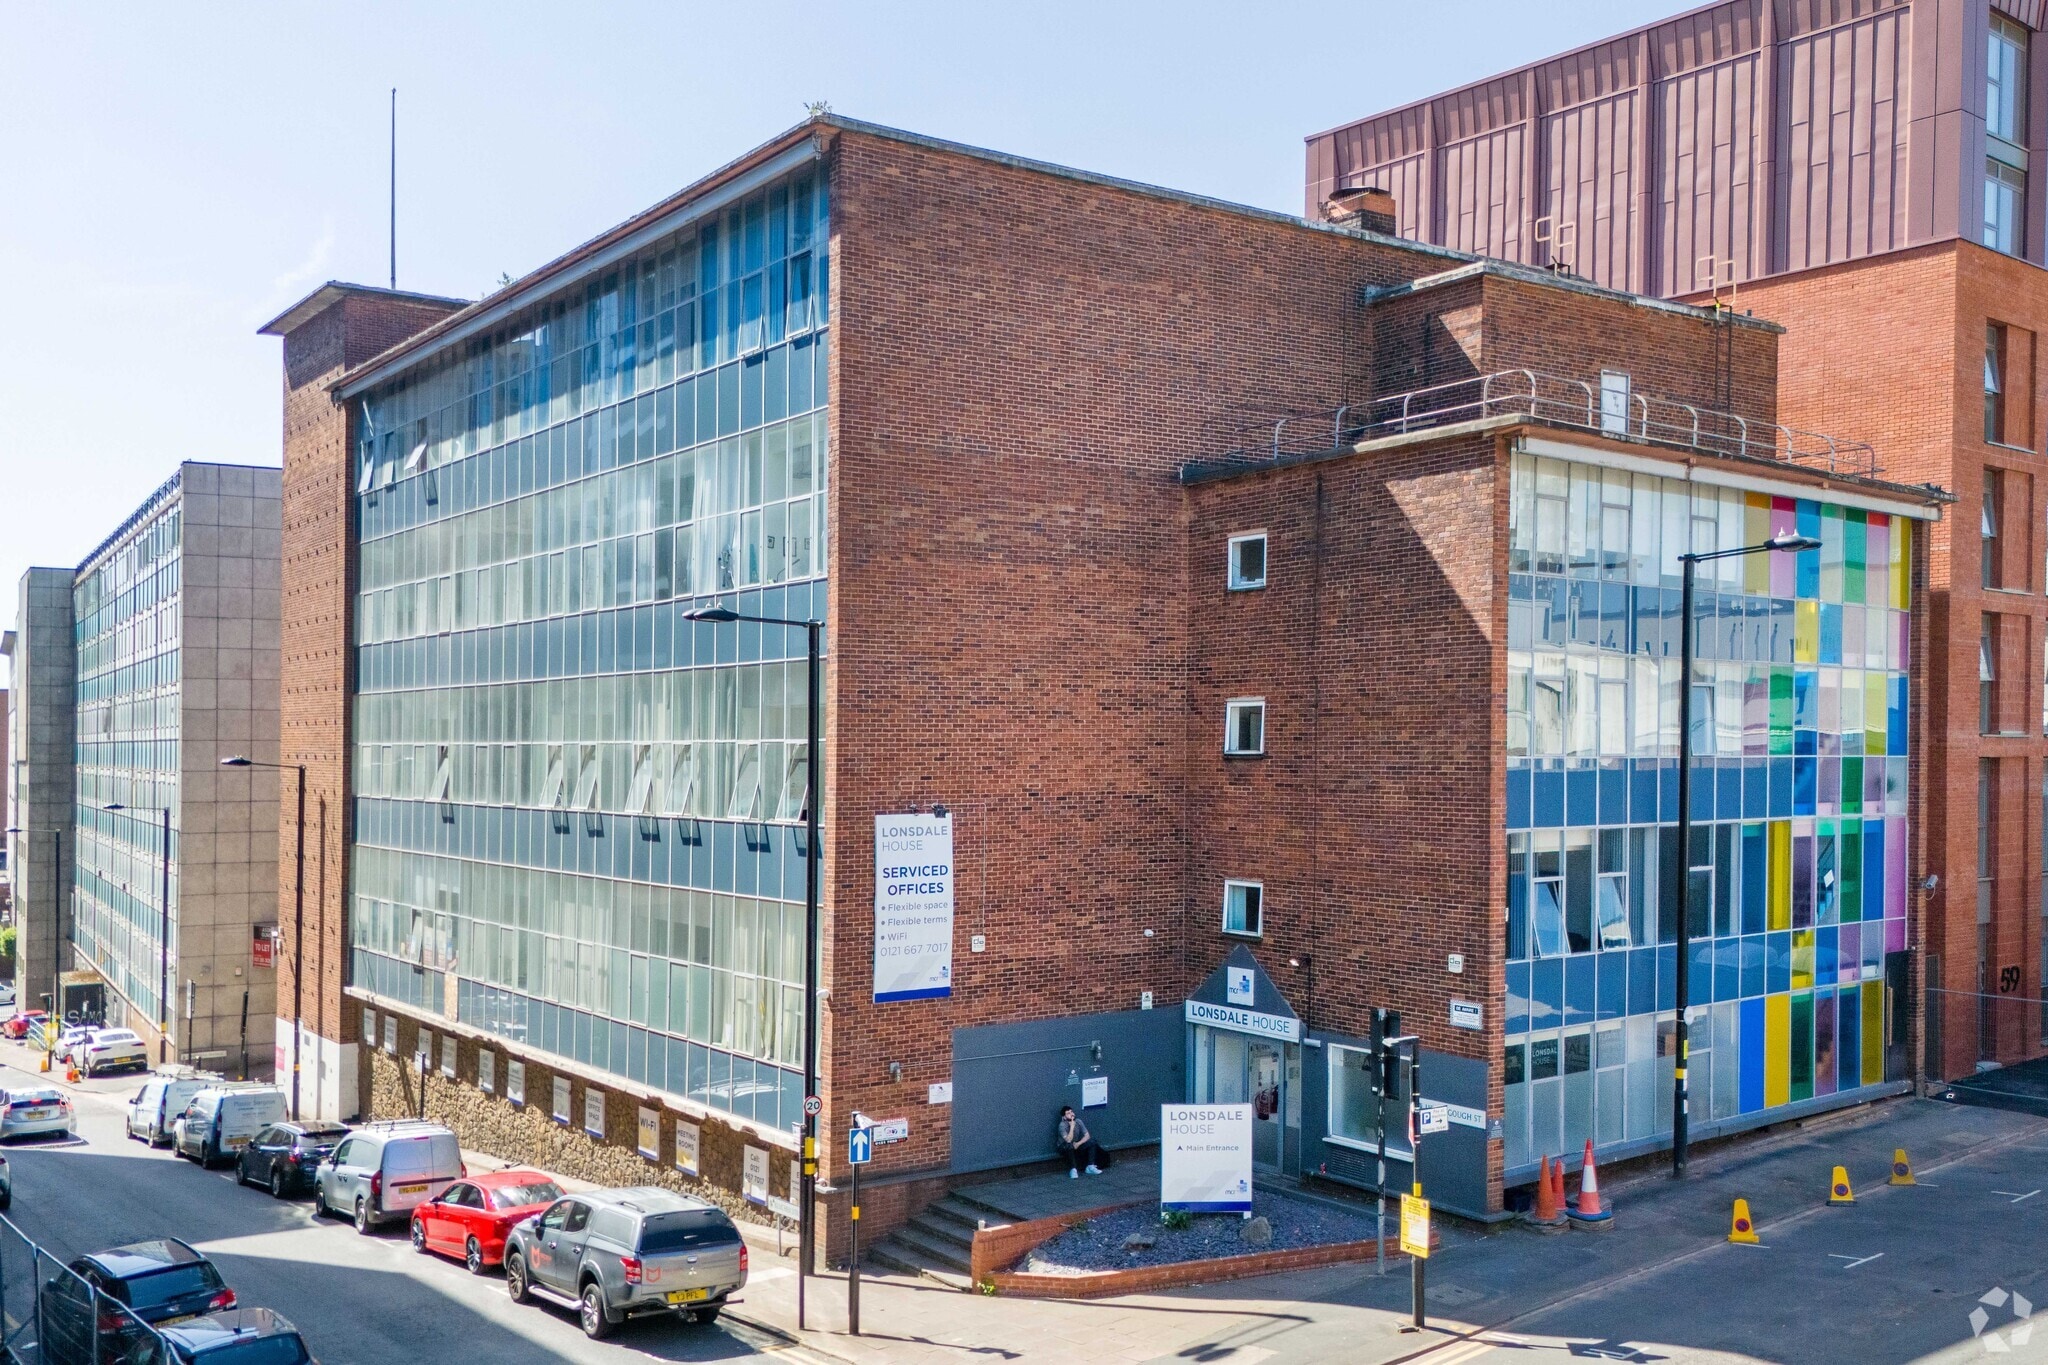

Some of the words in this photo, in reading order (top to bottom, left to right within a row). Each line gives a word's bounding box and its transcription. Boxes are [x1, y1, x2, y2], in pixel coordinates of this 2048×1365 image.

[882, 826, 948, 838] LONSDALE
[882, 840, 923, 852] HOUSE
[883, 865, 948, 879] SERVICED
[888, 882, 944, 896] OFFICES
[887, 903, 921, 911] Flexible
[924, 902, 948, 910] space
[887, 918, 921, 926] Flexible
[923, 916, 948, 924] terms
[887, 932, 907, 941] WiFi
[880, 946, 901, 957] 0121
[904, 945, 922, 955] 667
[926, 943, 948, 953] 7017
[2000, 966, 2020, 993] 59
[1192, 1005, 1248, 1025] LONSDALE
[1252, 1016, 1290, 1033] HOUSE
[807, 1101, 820, 1110] 20
[1170, 1111, 1243, 1121] LONSDALE
[1447, 1109, 1472, 1121] GOUGH
[1473, 1115, 1482, 1123] ST
[640, 1118, 656, 1131] WI-FI
[1170, 1124, 1215, 1134] HOUSE
[677, 1129, 696, 1142] MEETING
[678, 1139, 695, 1151] ROOMS
